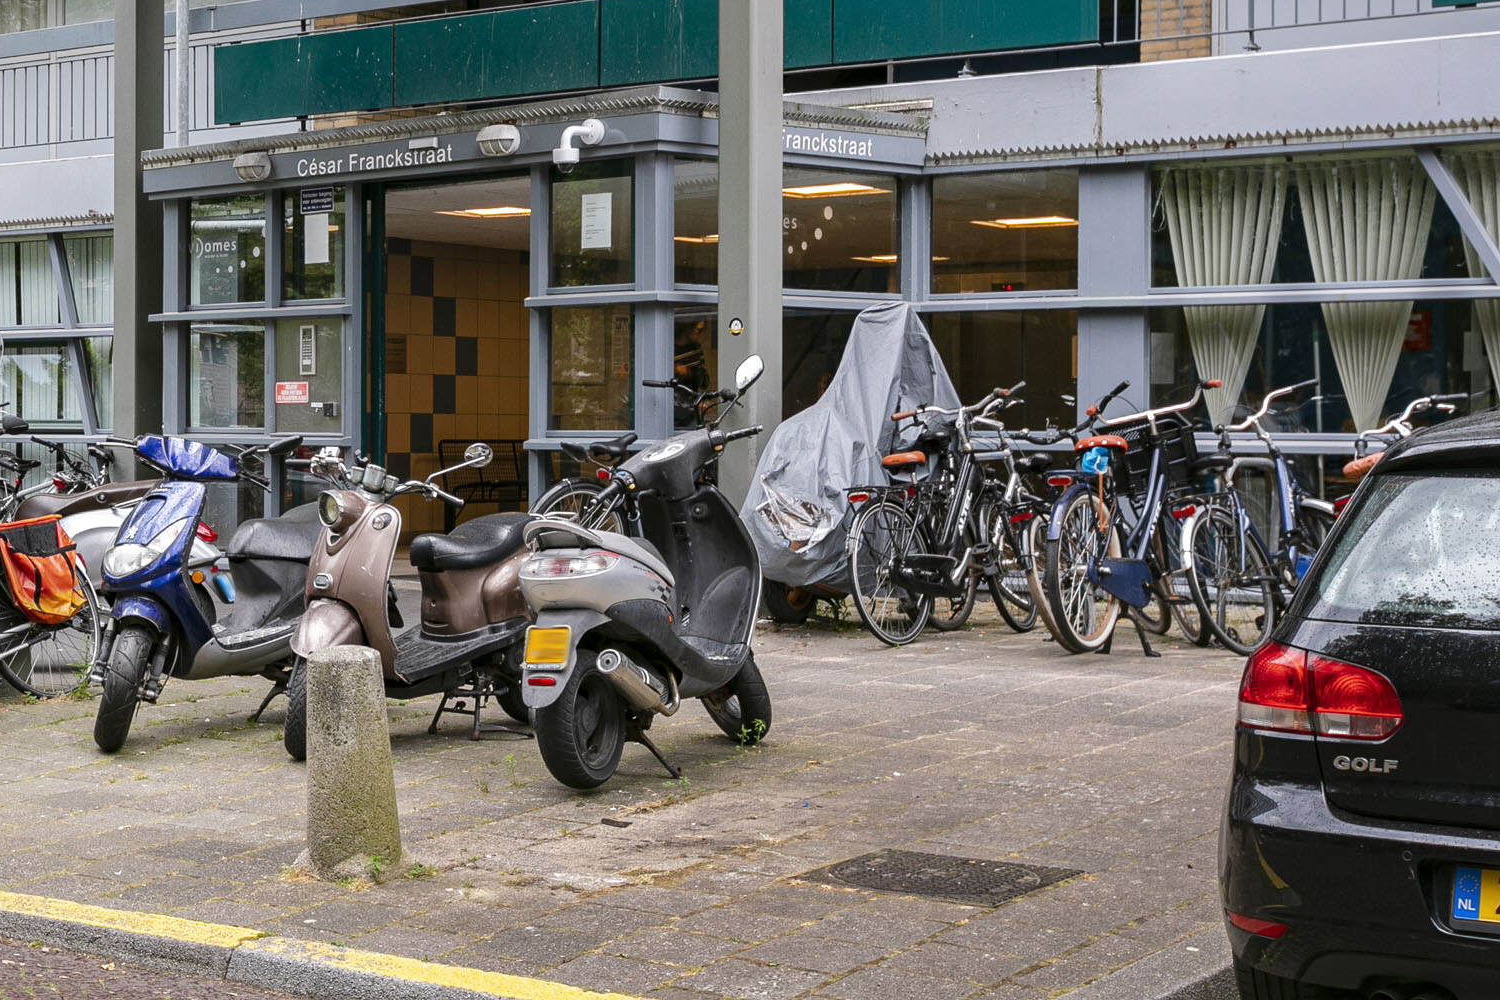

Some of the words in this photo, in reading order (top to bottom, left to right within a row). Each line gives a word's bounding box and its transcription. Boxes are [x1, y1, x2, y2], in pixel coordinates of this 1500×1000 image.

[297, 158, 342, 178] César
[349, 144, 453, 172] Franckstraat
[1332, 755, 1399, 774] GOLF
[1457, 898, 1476, 911] NL
